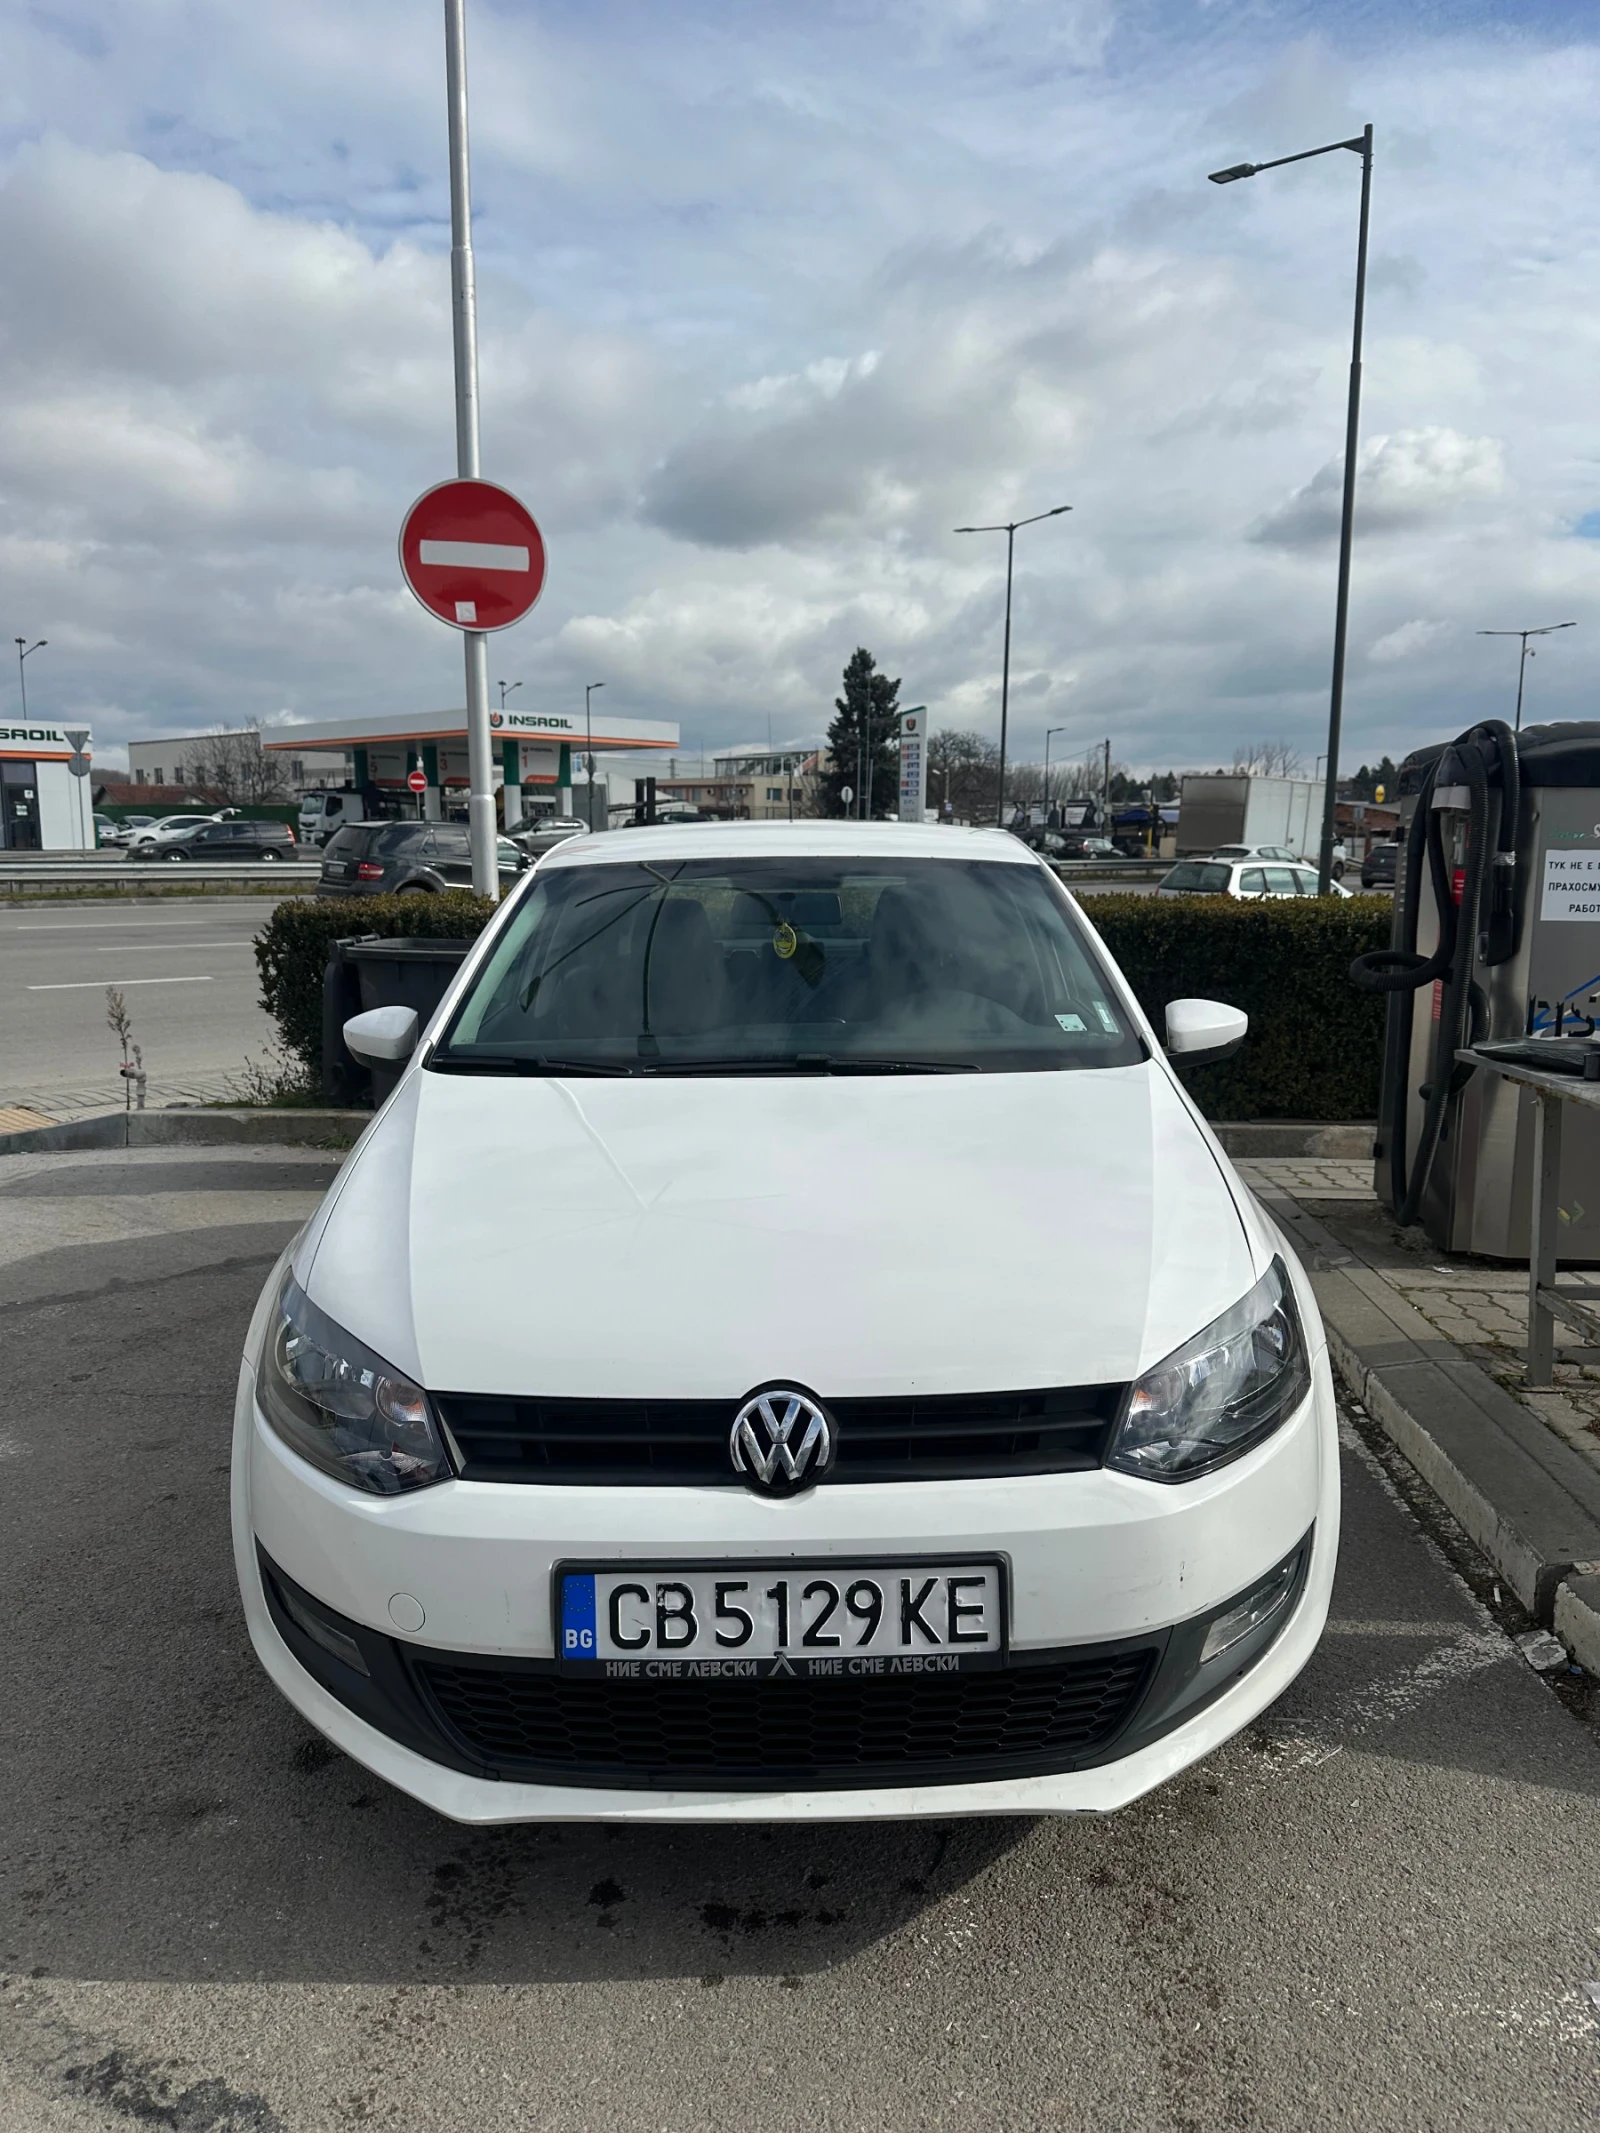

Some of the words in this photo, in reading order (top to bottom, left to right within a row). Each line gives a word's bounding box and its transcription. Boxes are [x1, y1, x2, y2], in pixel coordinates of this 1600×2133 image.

[508, 715, 573, 729] INSAOIL
[1549, 861, 1566, 870] ТУК
[1570, 861, 1583, 870] НЕ
[1587, 861, 1594, 870] Е
[565, 1629, 593, 1649] BG
[606, 1661, 640, 1677] НИЕ
[646, 1661, 682, 1677] СМЕ
[687, 1660, 758, 1677] ЛЕВСКИ
[808, 1658, 843, 1676] НИЕ
[848, 1657, 885, 1675] СМЕ
[890, 1655, 960, 1674] ЛЕВСКИ
